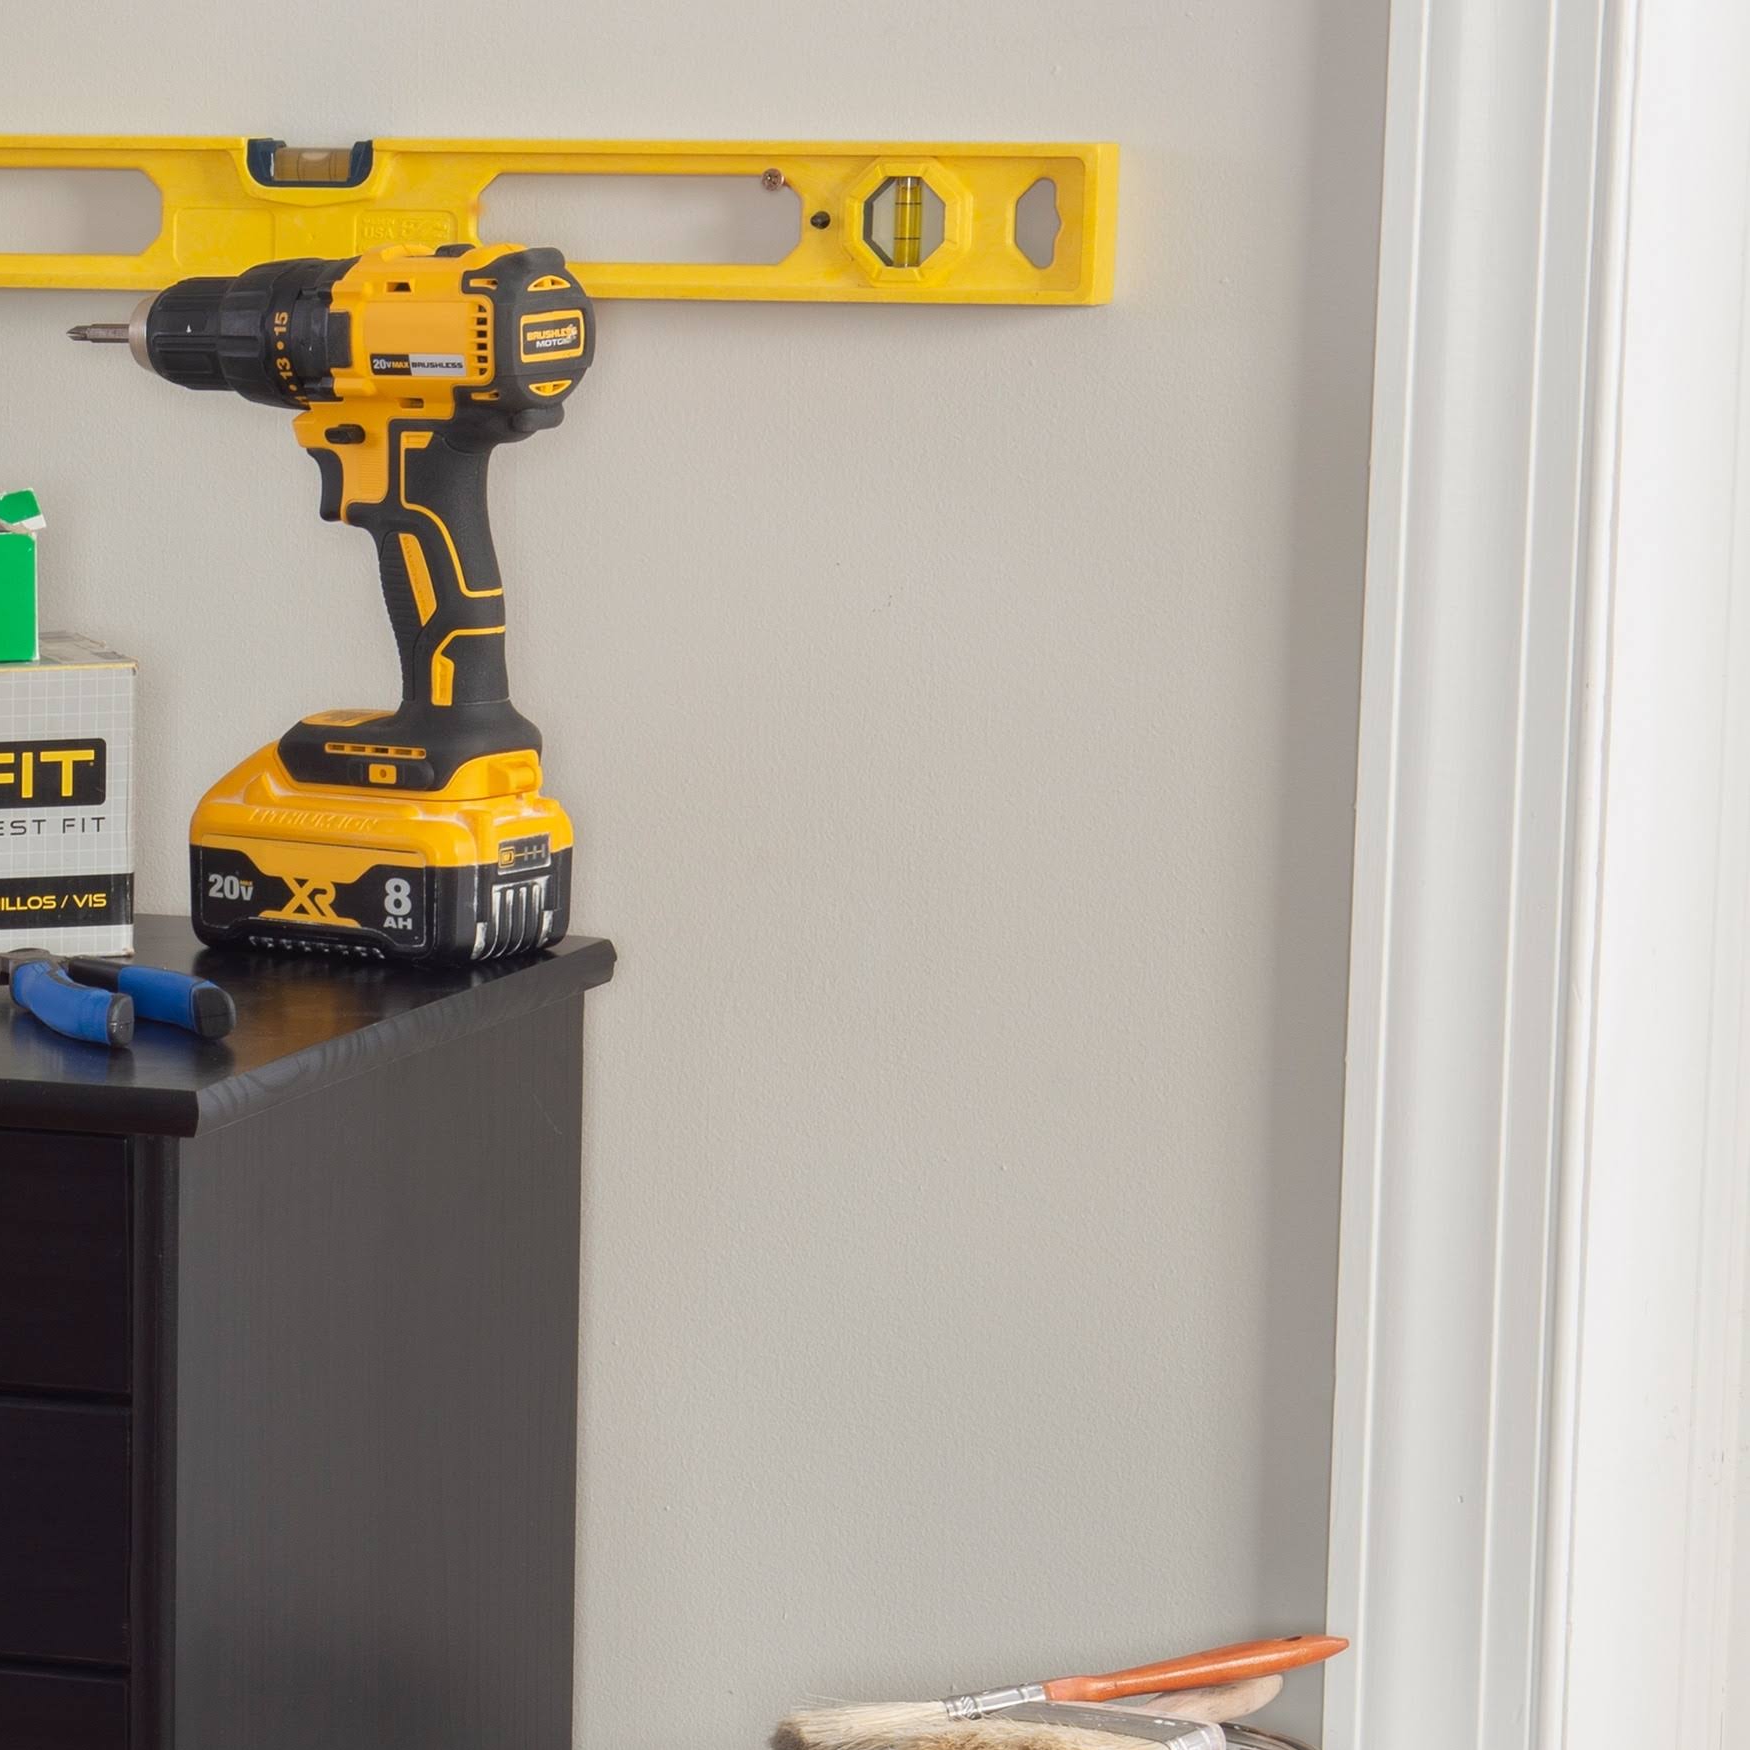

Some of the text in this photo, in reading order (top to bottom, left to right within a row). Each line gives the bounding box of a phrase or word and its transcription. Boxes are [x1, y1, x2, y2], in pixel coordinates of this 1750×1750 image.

[274, 311, 289, 336] 15
[276, 357, 294, 380] 13
[411, 361, 463, 369] BRUSHLESS
[62, 816, 107, 834] FIT
[72, 893, 107, 909] VIS
[272, 875, 346, 921] XR
[383, 877, 412, 916] 8
[383, 917, 413, 931] AH
